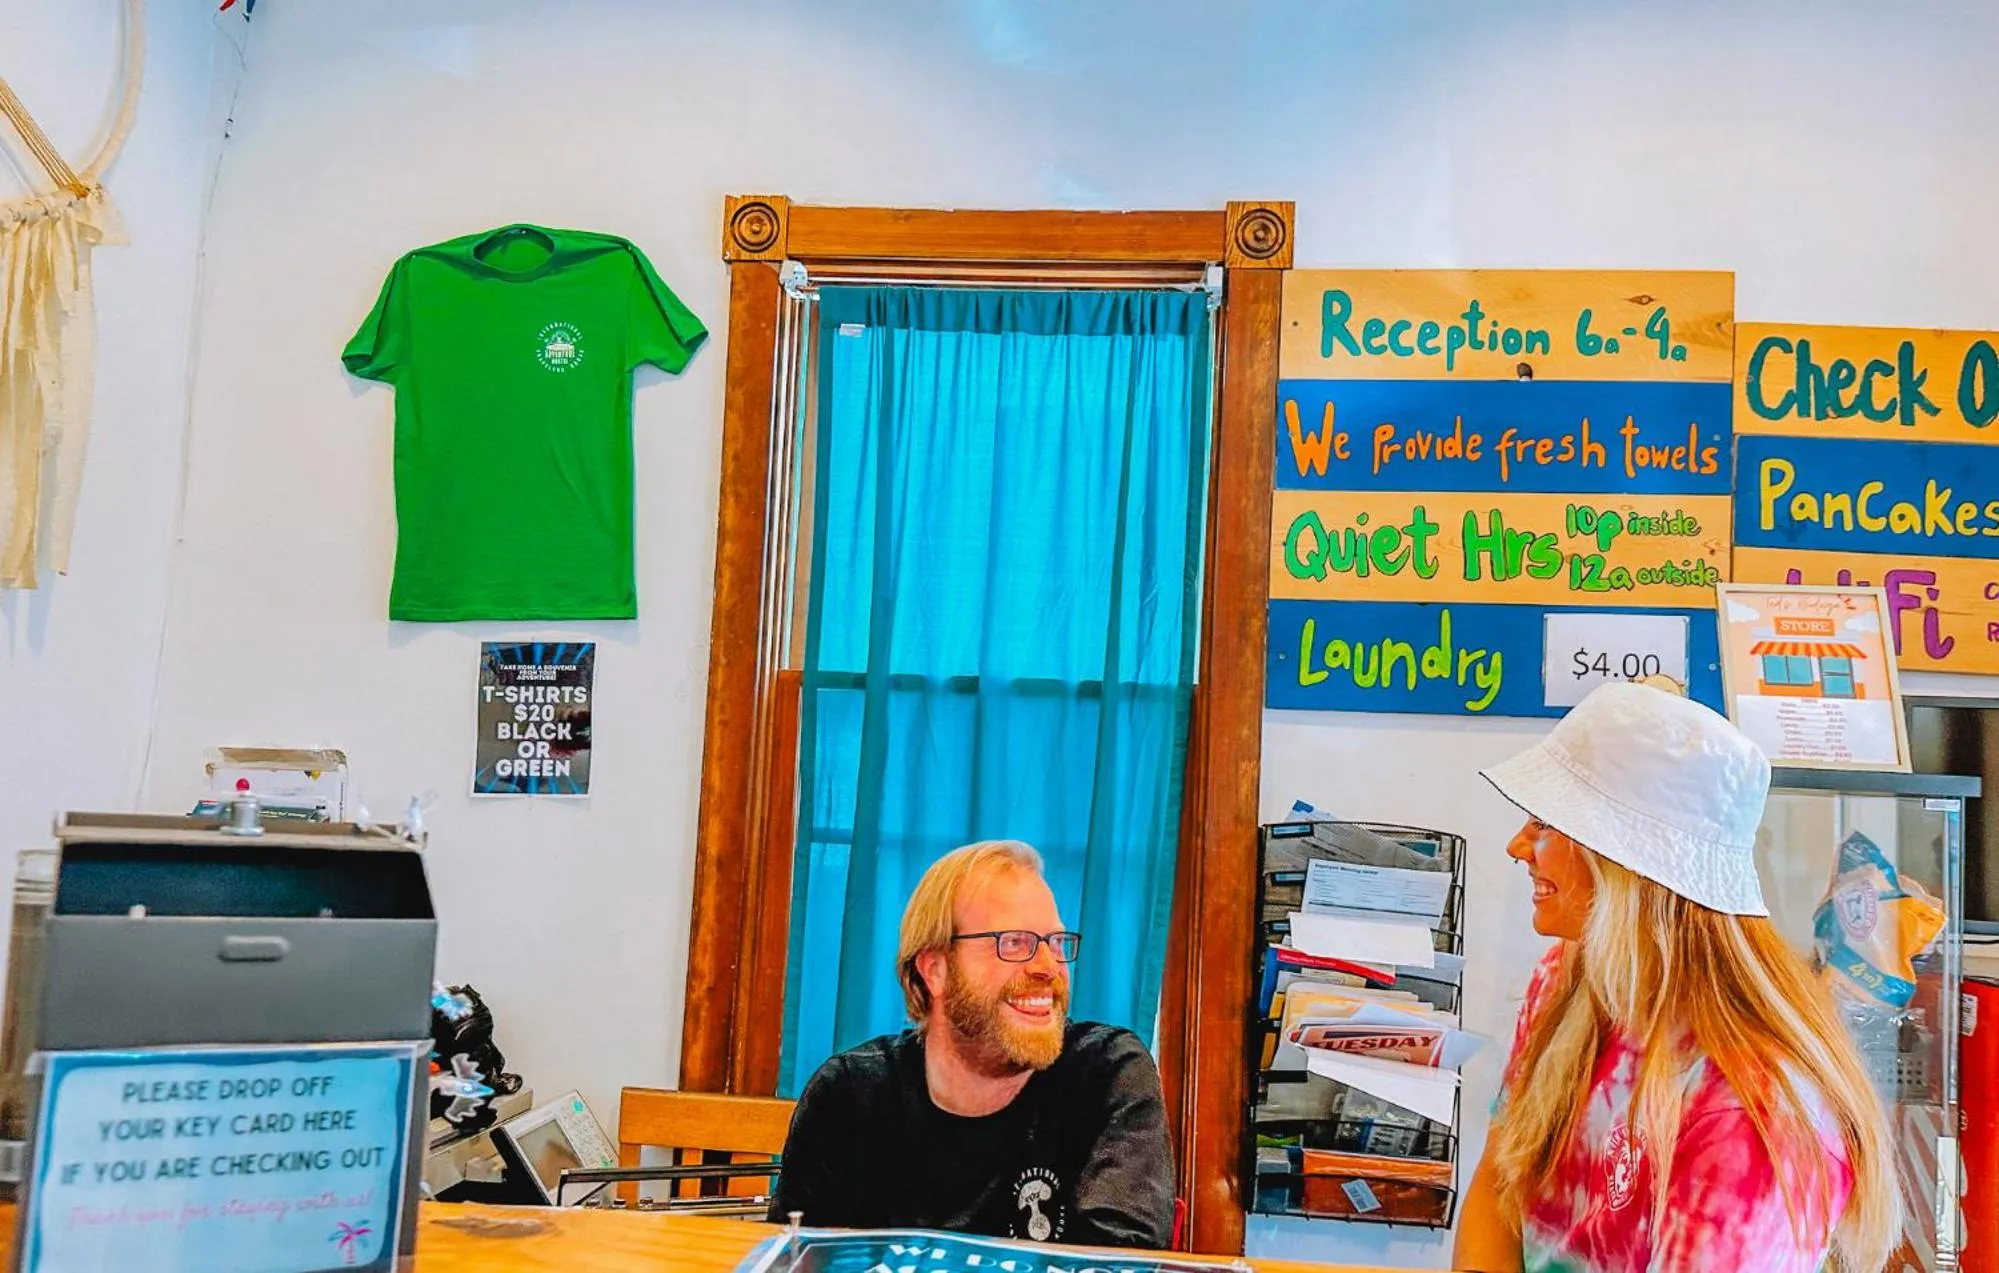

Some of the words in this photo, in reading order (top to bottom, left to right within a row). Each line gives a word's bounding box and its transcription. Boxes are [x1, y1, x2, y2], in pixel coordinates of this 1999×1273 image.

[1320, 290, 1550, 372] Reception
[1746, 336, 1941, 426] Check
[1285, 399, 1351, 477] We
[1494, 417, 1605, 482] fresh
[1619, 415, 1719, 479] towels
[1284, 505, 1440, 581] Quiet
[1462, 509, 1564, 582] Hrs
[1566, 504, 1623, 552] 10p
[1627, 509, 1702, 537] inside
[1569, 553, 1634, 592] 12a
[1780, 620, 1831, 632] STORE
[1299, 608, 1502, 712] Laundry
[1572, 648, 1660, 681] $4.00
[483, 685, 587, 703] T-SHIRTS
[514, 704, 555, 722] $20
[497, 722, 572, 740] BLACK
[517, 741, 550, 758] OR
[495, 759, 570, 777] GREEN
[1311, 1036, 1438, 1052] TUESDAY
[122, 1079, 210, 1104] PLEASE
[219, 1076, 281, 1100] DROP
[291, 1075, 335, 1097] OFF
[99, 1117, 165, 1142] YOUR
[174, 1114, 221, 1138] KEY
[230, 1112, 294, 1135] CARD
[303, 1109, 357, 1132] HERE
[62, 1163, 81, 1185] IF
[95, 1159, 145, 1183] YOU
[154, 1156, 201, 1180] ARE
[210, 1149, 330, 1177] CHECKING
[340, 1145, 386, 1169] OUT
[220, 1198, 290, 1222] staying
[296, 1191, 338, 1211] with
